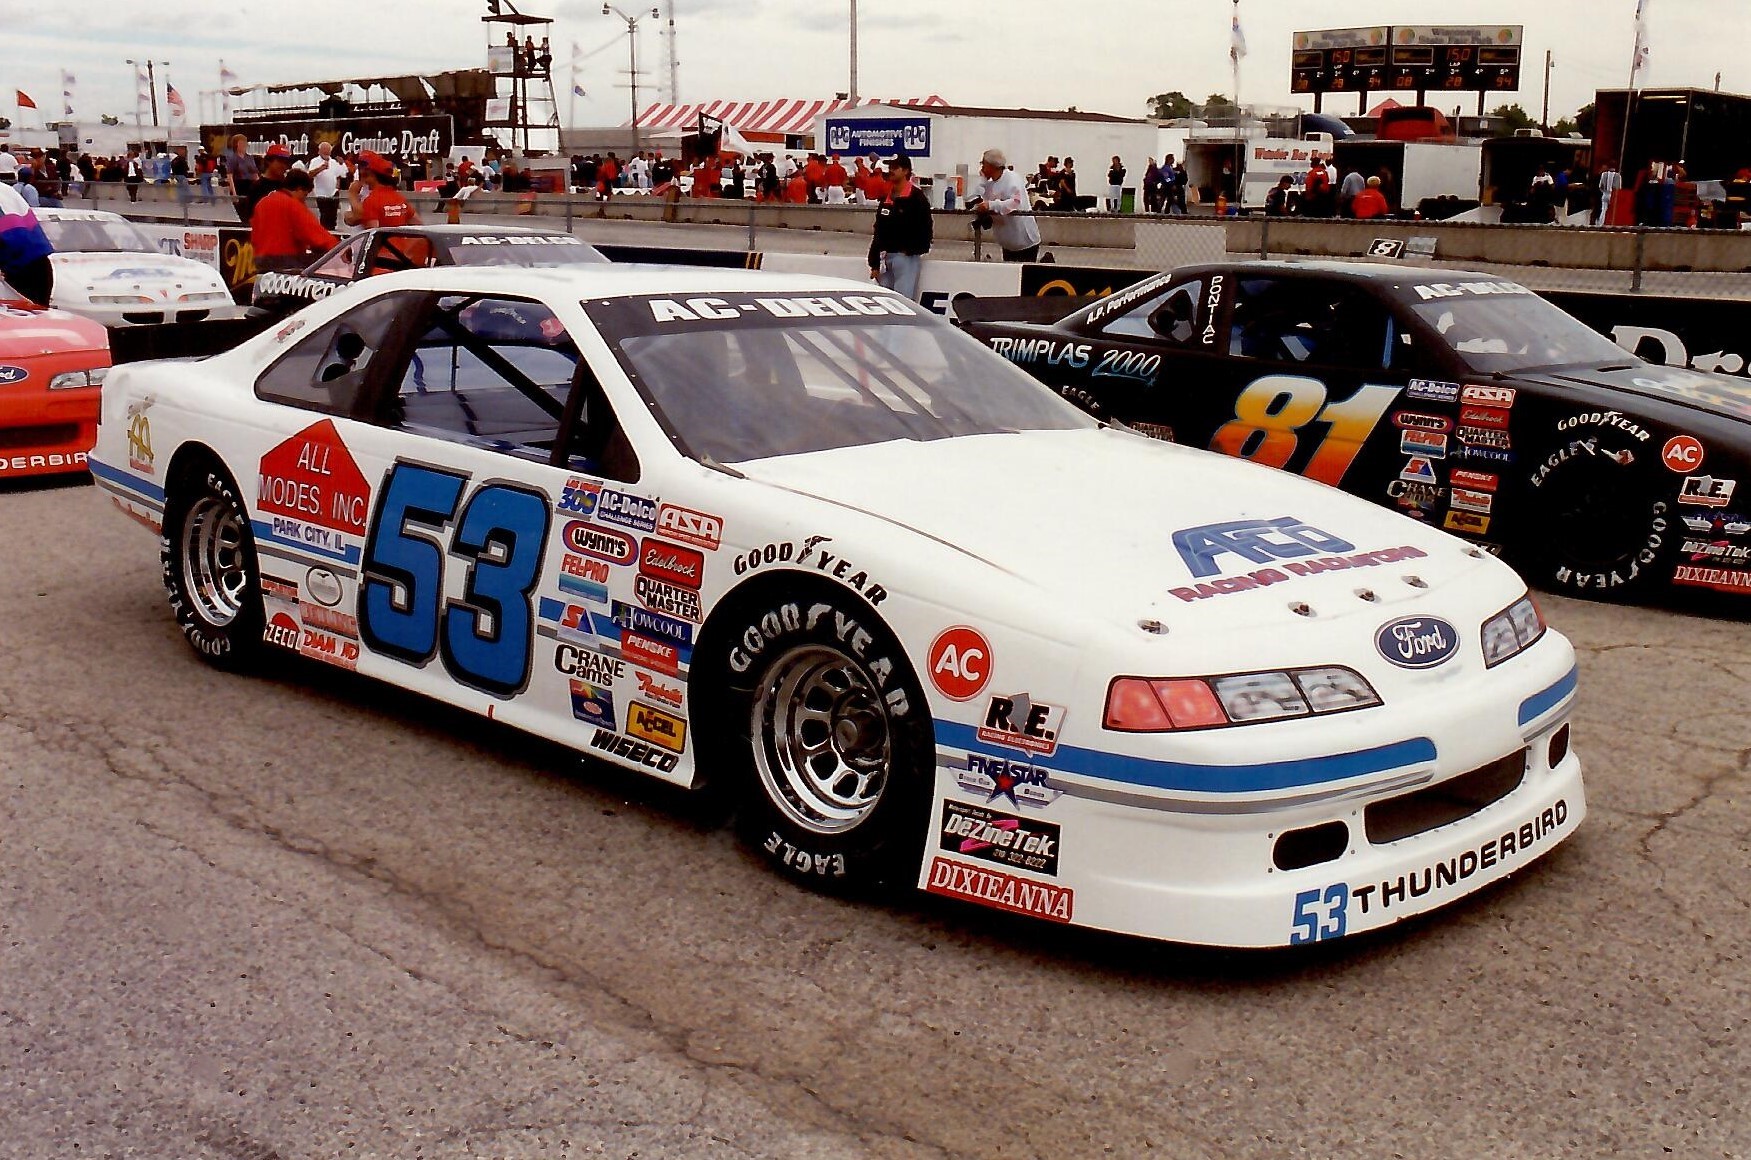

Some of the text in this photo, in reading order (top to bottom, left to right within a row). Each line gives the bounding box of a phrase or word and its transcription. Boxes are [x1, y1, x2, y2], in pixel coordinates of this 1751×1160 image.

[342, 131, 399, 155] Genuine
[402, 128, 440, 155] Draft
[830, 125, 926, 149] PPG AUTOMOTIVE PPG
[649, 297, 916, 323] AC-DELCO
[1202, 275, 1224, 345] PONTIAC
[990, 337, 1161, 377] TRIMPLAS 2000
[1061, 385, 1100, 410] EAGLE
[1462, 385, 1513, 402] ASA
[1210, 374, 1402, 487] 81
[297, 442, 331, 475] ALL
[1667, 443, 1698, 463] AC
[332, 491, 366, 527] INC.
[558, 487, 598, 515] 300
[600, 491, 656, 521] AC-Delco
[273, 517, 301, 538] PARK
[334, 533, 345, 552] IL
[660, 507, 720, 541] ASA
[645, 549, 696, 578] Edelbrock
[1172, 516, 1356, 578] AFCO
[360, 457, 553, 700] 53
[637, 577, 699, 605] QUARTER
[1168, 545, 1429, 603] RACING RADIATORS
[646, 594, 700, 620] MASTER
[627, 634, 673, 658] PENSKE
[1392, 621, 1448, 660] Ford
[555, 644, 626, 679] CRANE
[935, 644, 983, 681] AC
[590, 728, 679, 774] WISECO
[764, 831, 846, 876] EAGLE
[1289, 798, 1568, 946] 53 THUNDERBIRD
[931, 860, 1070, 920] DIXIEANNA
